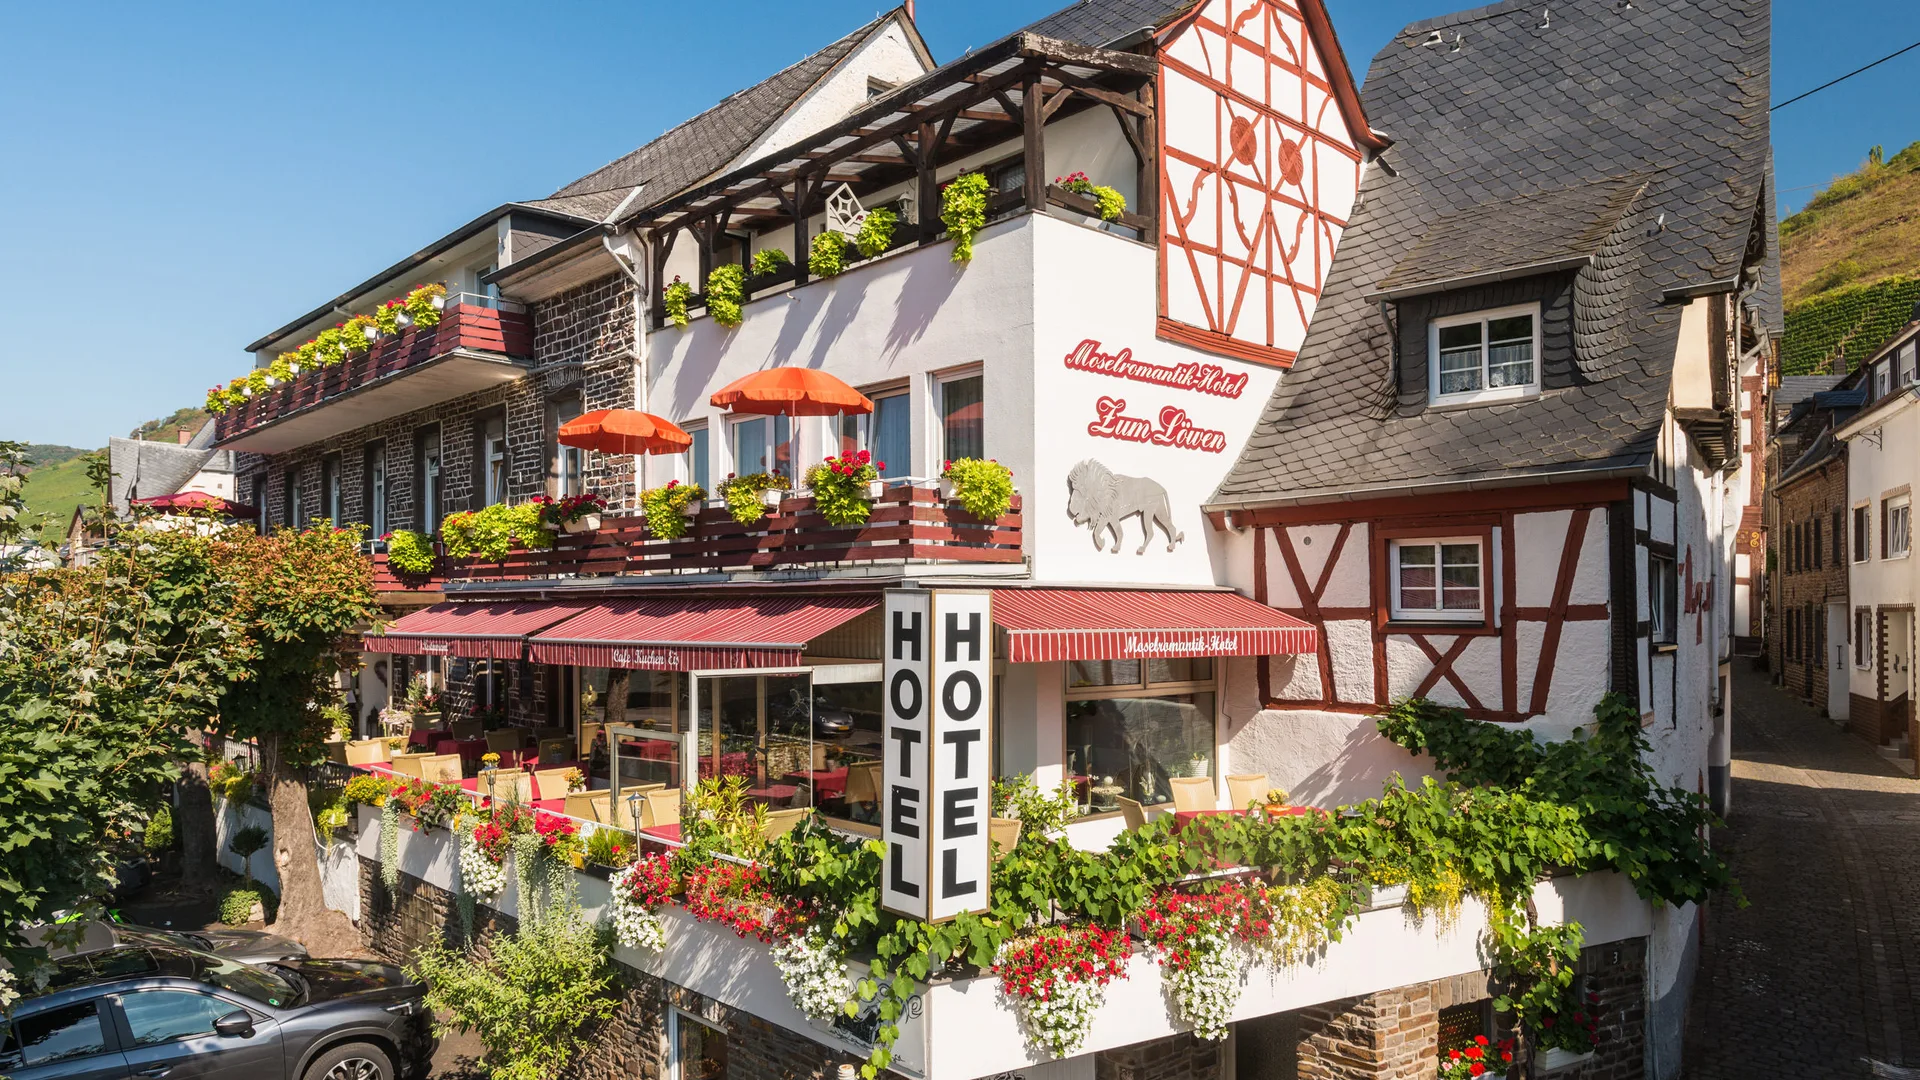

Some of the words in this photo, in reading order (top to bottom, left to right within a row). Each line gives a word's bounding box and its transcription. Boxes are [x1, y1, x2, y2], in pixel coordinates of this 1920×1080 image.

[1066, 342, 1247, 396] Moselromantik-Hotel
[1090, 398, 1151, 440] Zum
[1153, 407, 1226, 452] Löwen
[1124, 635, 1238, 653] Moselromantik-Hotel
[890, 611, 923, 899] HOTEL
[942, 612, 981, 900] HOTEL
[1613, 951, 1619, 964] 3
